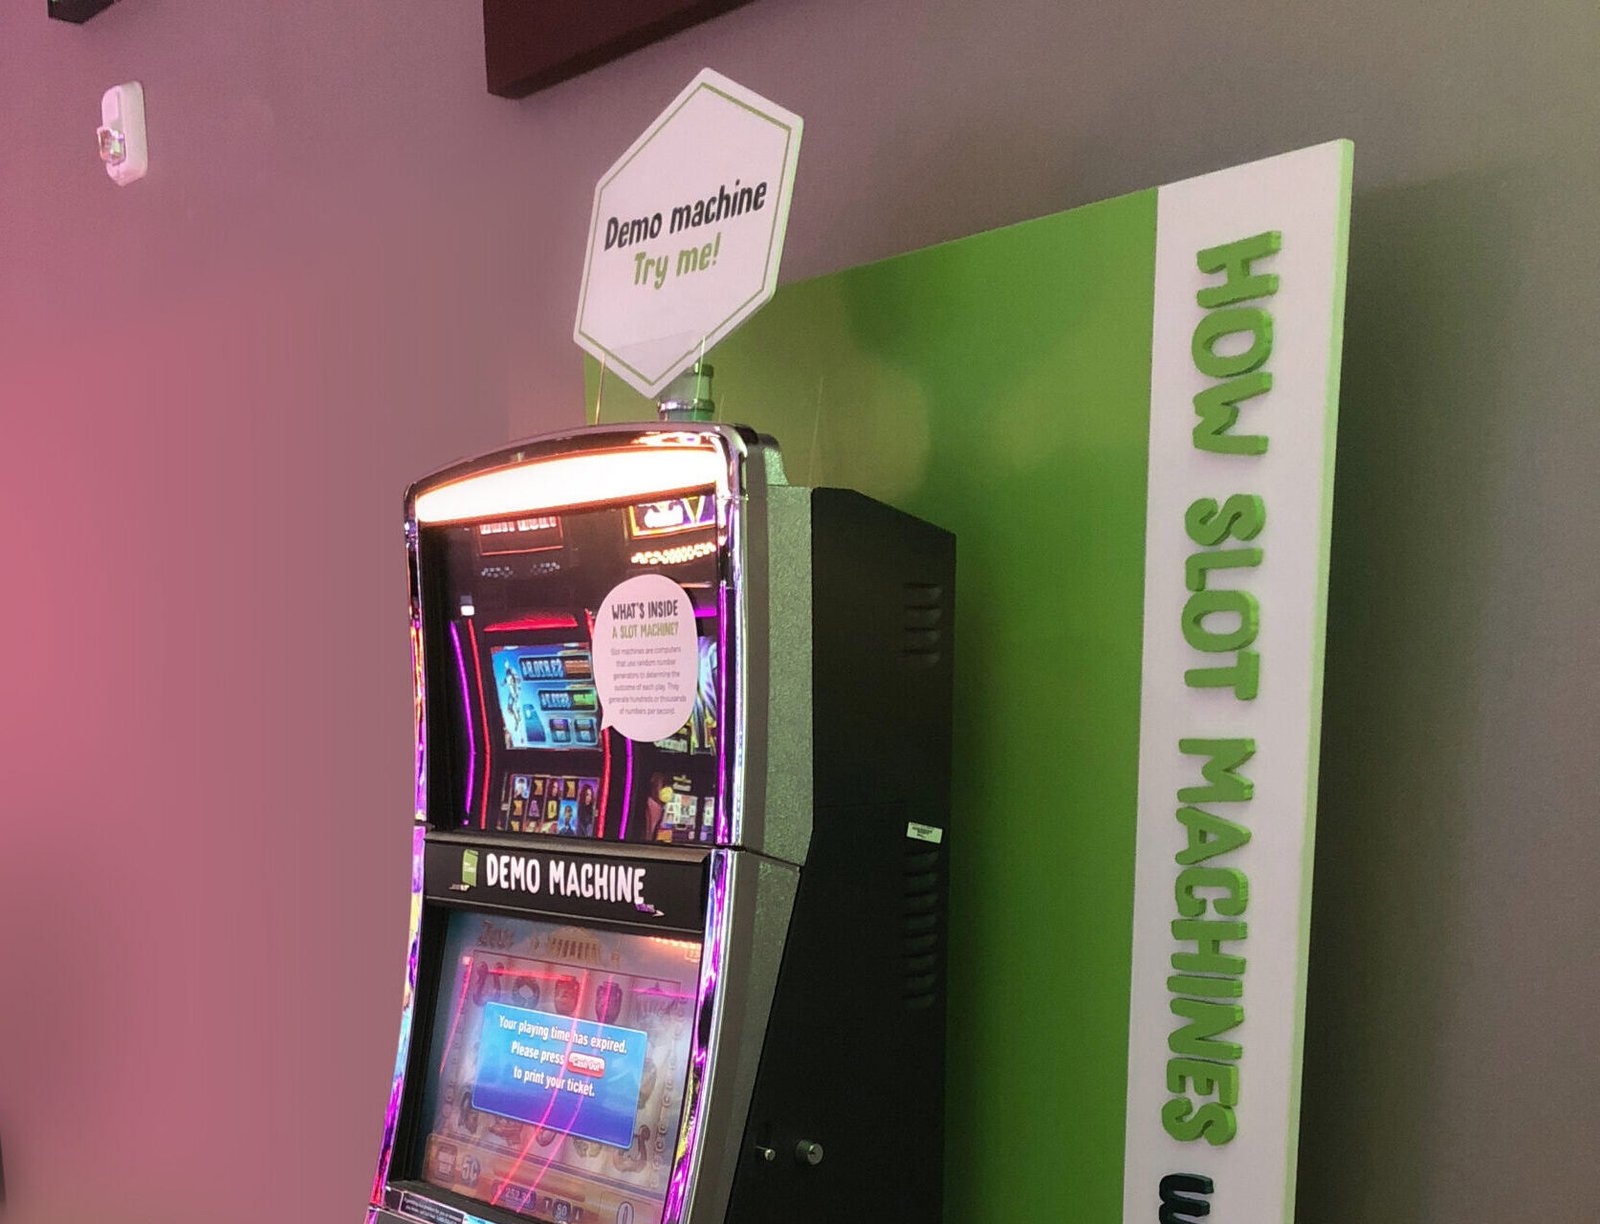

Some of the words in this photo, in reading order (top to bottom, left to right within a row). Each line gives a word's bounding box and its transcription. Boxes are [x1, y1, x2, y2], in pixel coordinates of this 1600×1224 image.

[603, 212, 662, 251] Demo
[669, 178, 768, 235] machine
[633, 251, 669, 290] Try
[676, 231, 721, 277] me!
[1191, 229, 1282, 457] HOW
[611, 602, 645, 620] WHAT'S
[648, 600, 678, 619] INSIDE
[1181, 493, 1266, 702] SLOT
[612, 626, 618, 639] A
[620, 624, 638, 639] SLOT
[640, 621, 679, 638] MACHINE?
[486, 853, 541, 894] DEMO
[549, 859, 647, 904] MACHINE
[1161, 737, 1257, 1147] MACHINES
[499, 1015, 516, 1030] Your
[518, 1019, 549, 1041] playing
[550, 1023, 571, 1042] time
[572, 1031, 589, 1047] has
[590, 1036, 628, 1054] expired.
[511, 1040, 539, 1060] Please
[540, 1050, 565, 1066] press
[513, 1065, 523, 1080] to
[523, 1069, 545, 1085] print
[545, 1076, 565, 1091] your
[566, 1079, 595, 1097] ticket.
